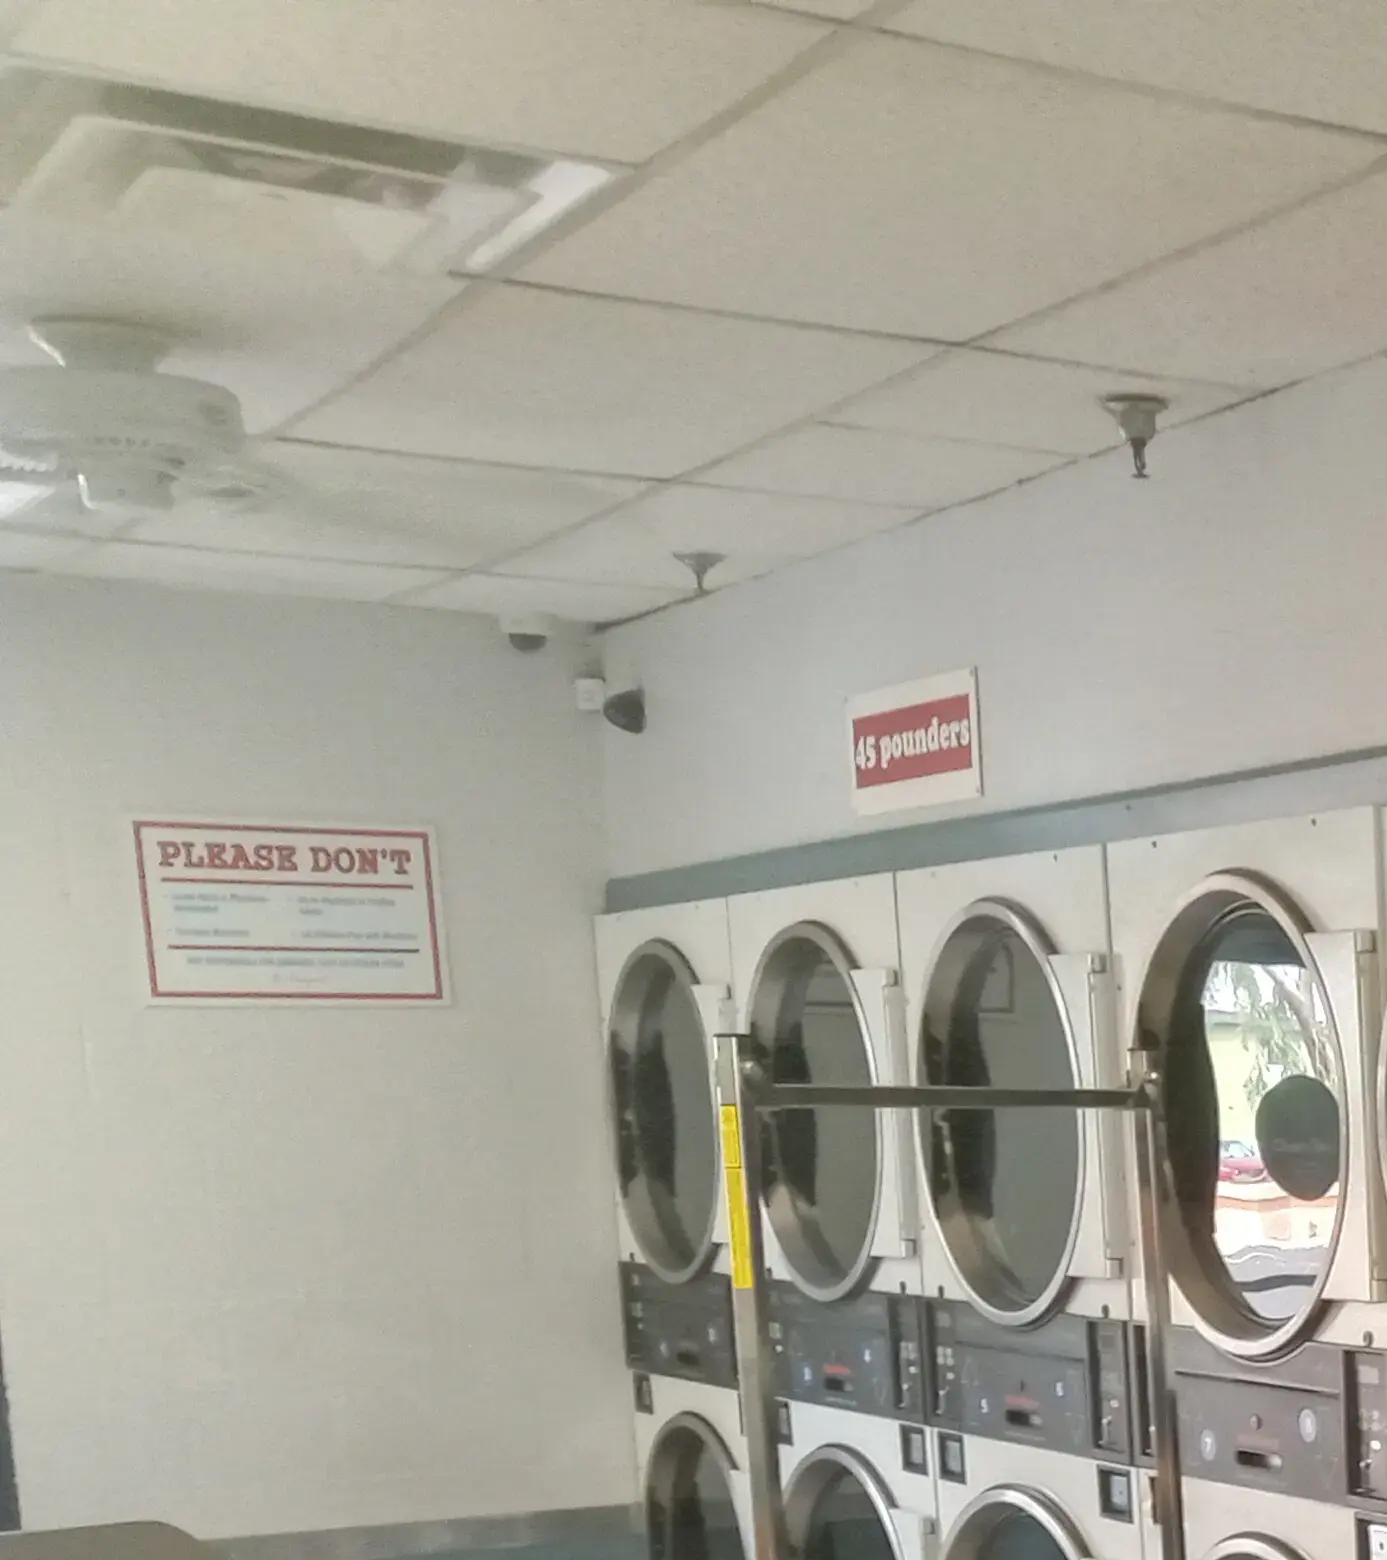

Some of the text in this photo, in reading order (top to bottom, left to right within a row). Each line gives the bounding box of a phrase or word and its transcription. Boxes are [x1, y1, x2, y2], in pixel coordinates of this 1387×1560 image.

[855, 716, 970, 770] 45 pounders
[156, 841, 412, 875] PLEASE DON'T
